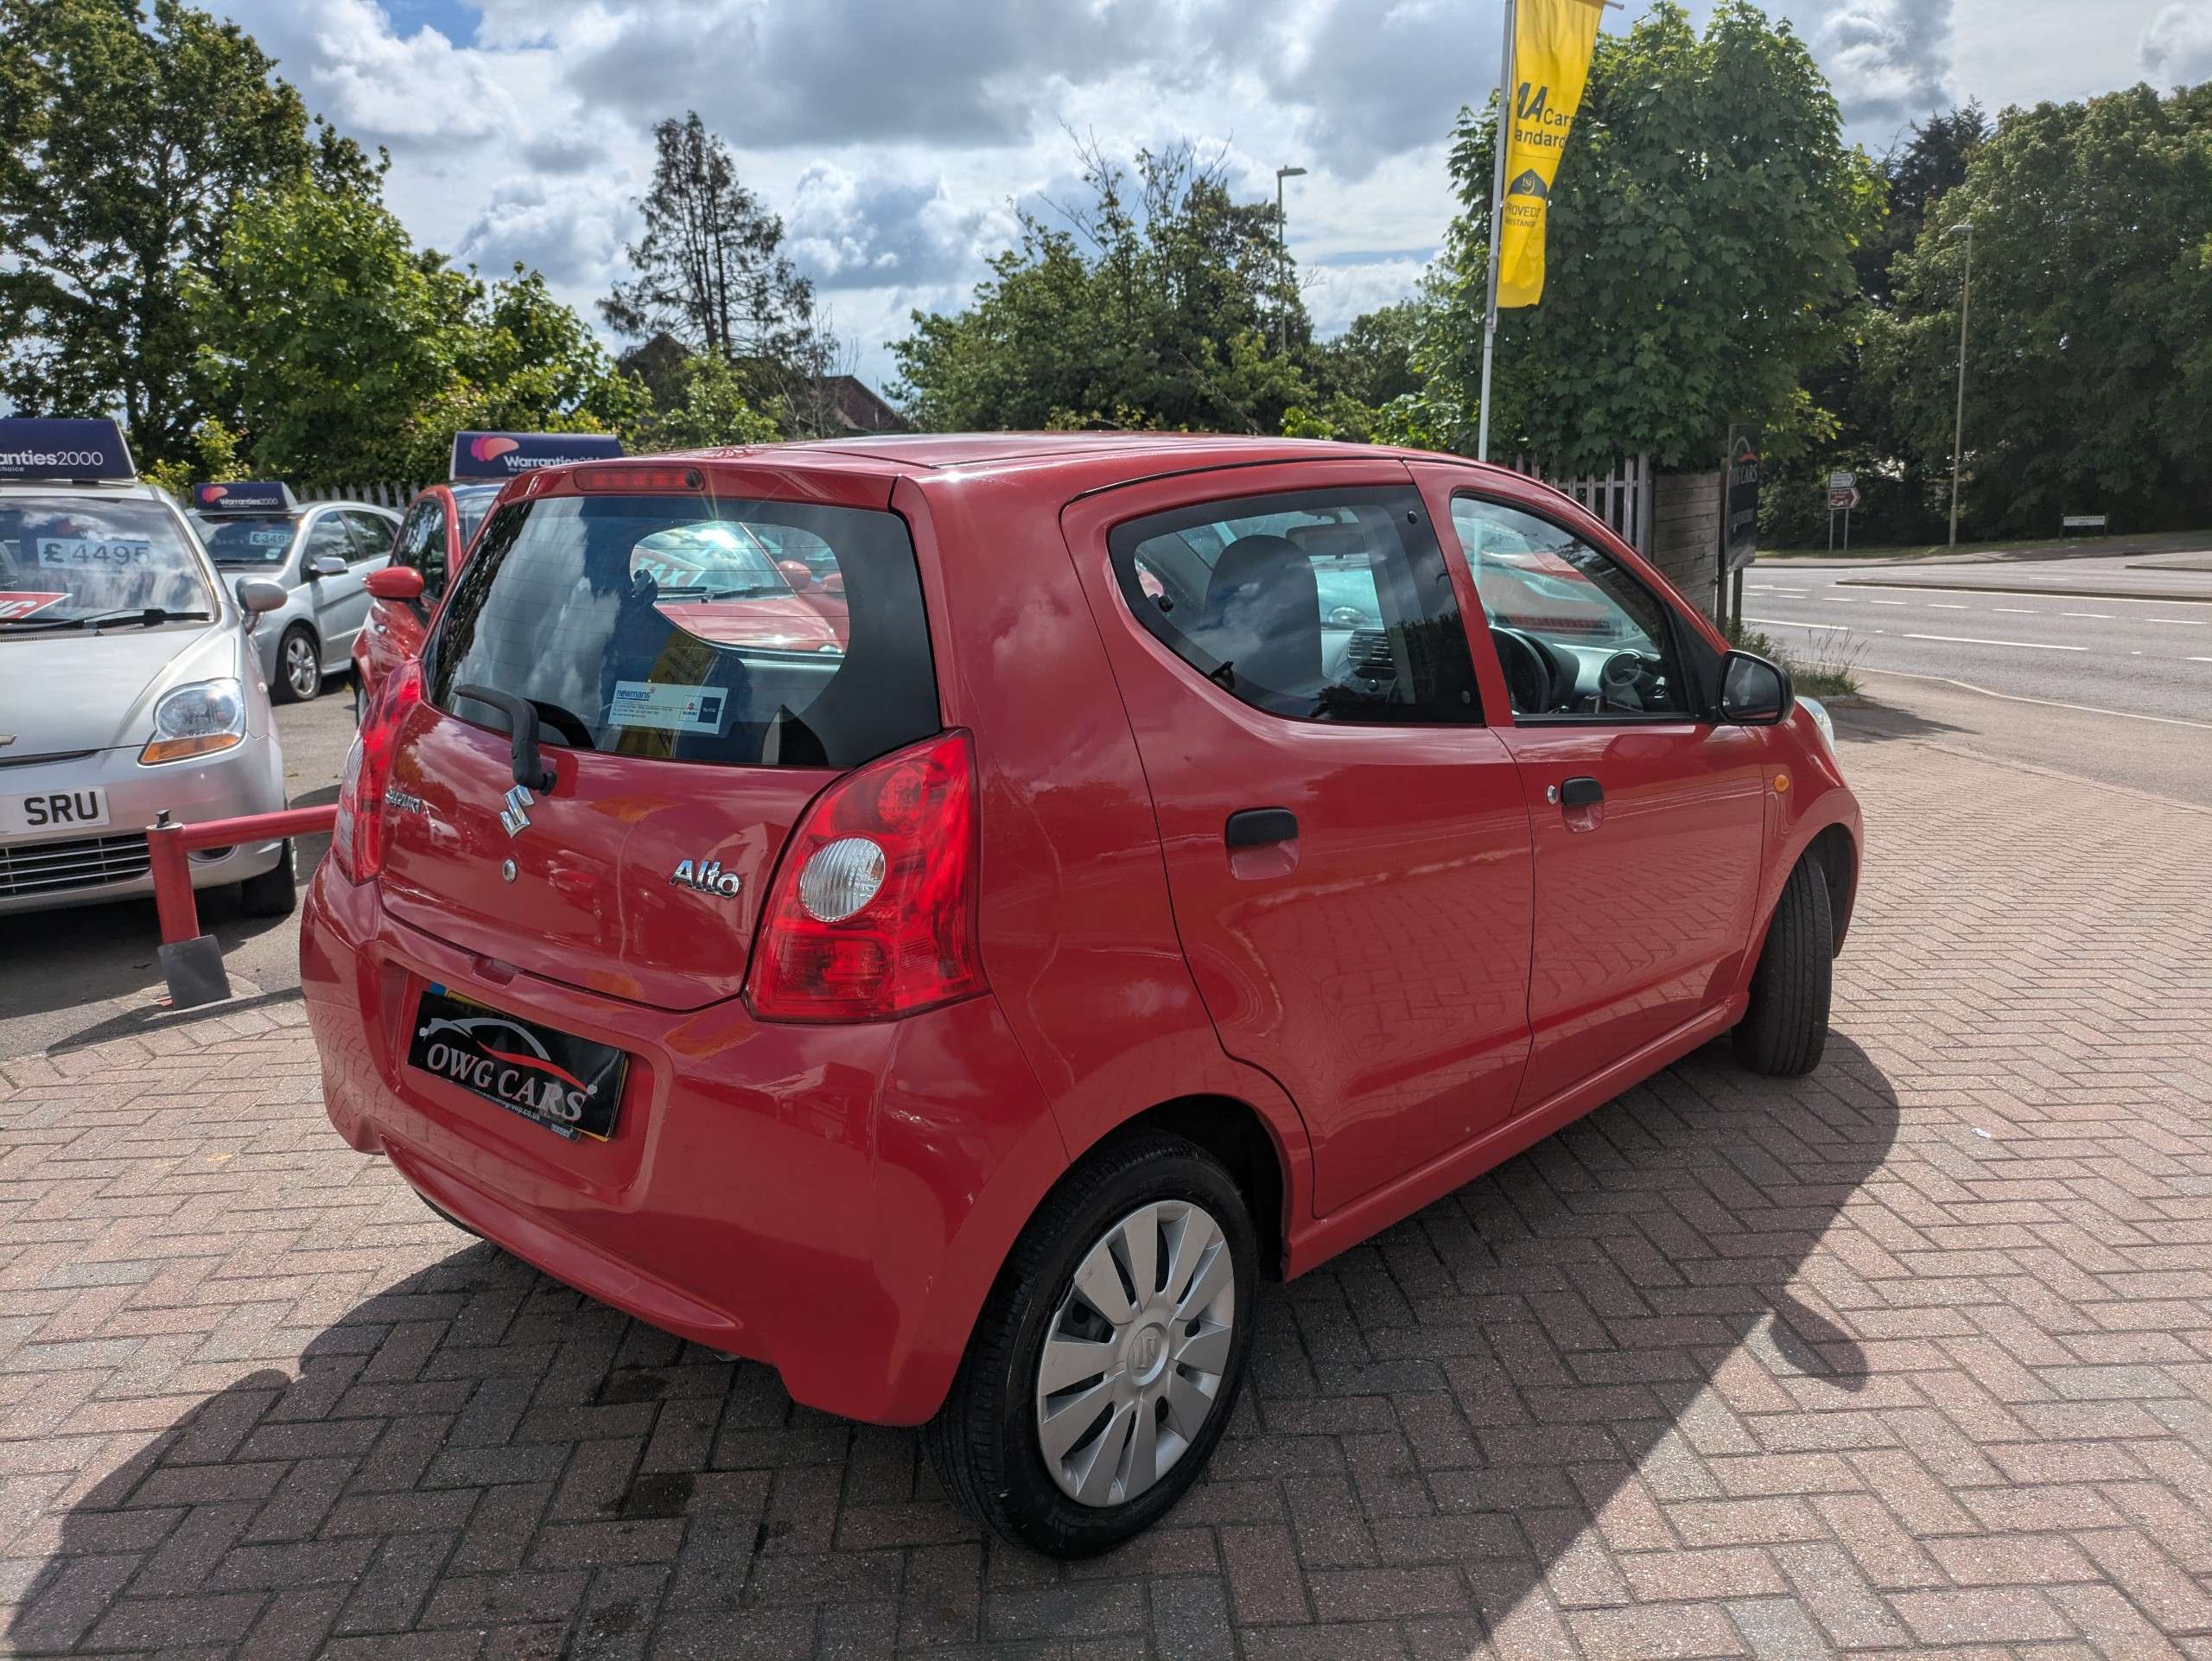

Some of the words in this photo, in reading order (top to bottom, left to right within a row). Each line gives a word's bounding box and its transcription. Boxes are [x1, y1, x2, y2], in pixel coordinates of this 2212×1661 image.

[23, 791, 99, 826] SRU
[669, 858, 740, 899] Alto
[427, 1043, 495, 1088] OWG
[497, 1069, 588, 1123] CARS
